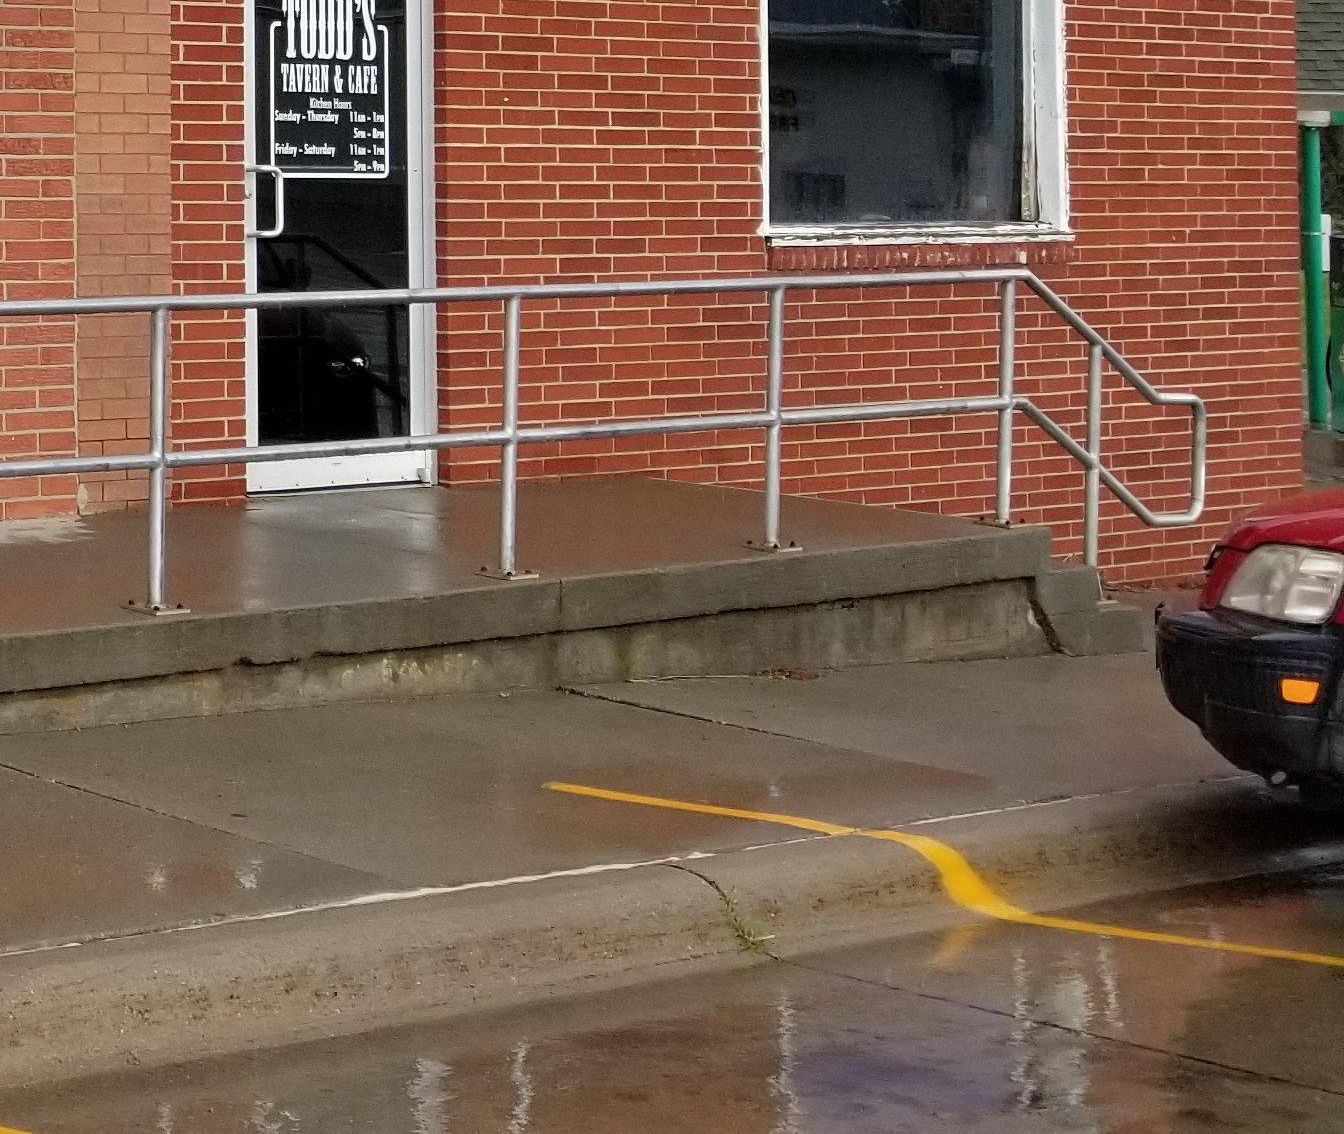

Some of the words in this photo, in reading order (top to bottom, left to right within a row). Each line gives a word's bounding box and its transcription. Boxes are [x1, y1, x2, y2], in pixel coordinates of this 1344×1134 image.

[280, 63, 329, 93] TAVERN
[334, 65, 343, 93] &
[348, 65, 377, 94] CAFE
[274, 110, 301, 124] Sunday
[307, 110, 339, 124] Thursday
[275, 143, 297, 157] Friday
[304, 143, 335, 157] Saturday
